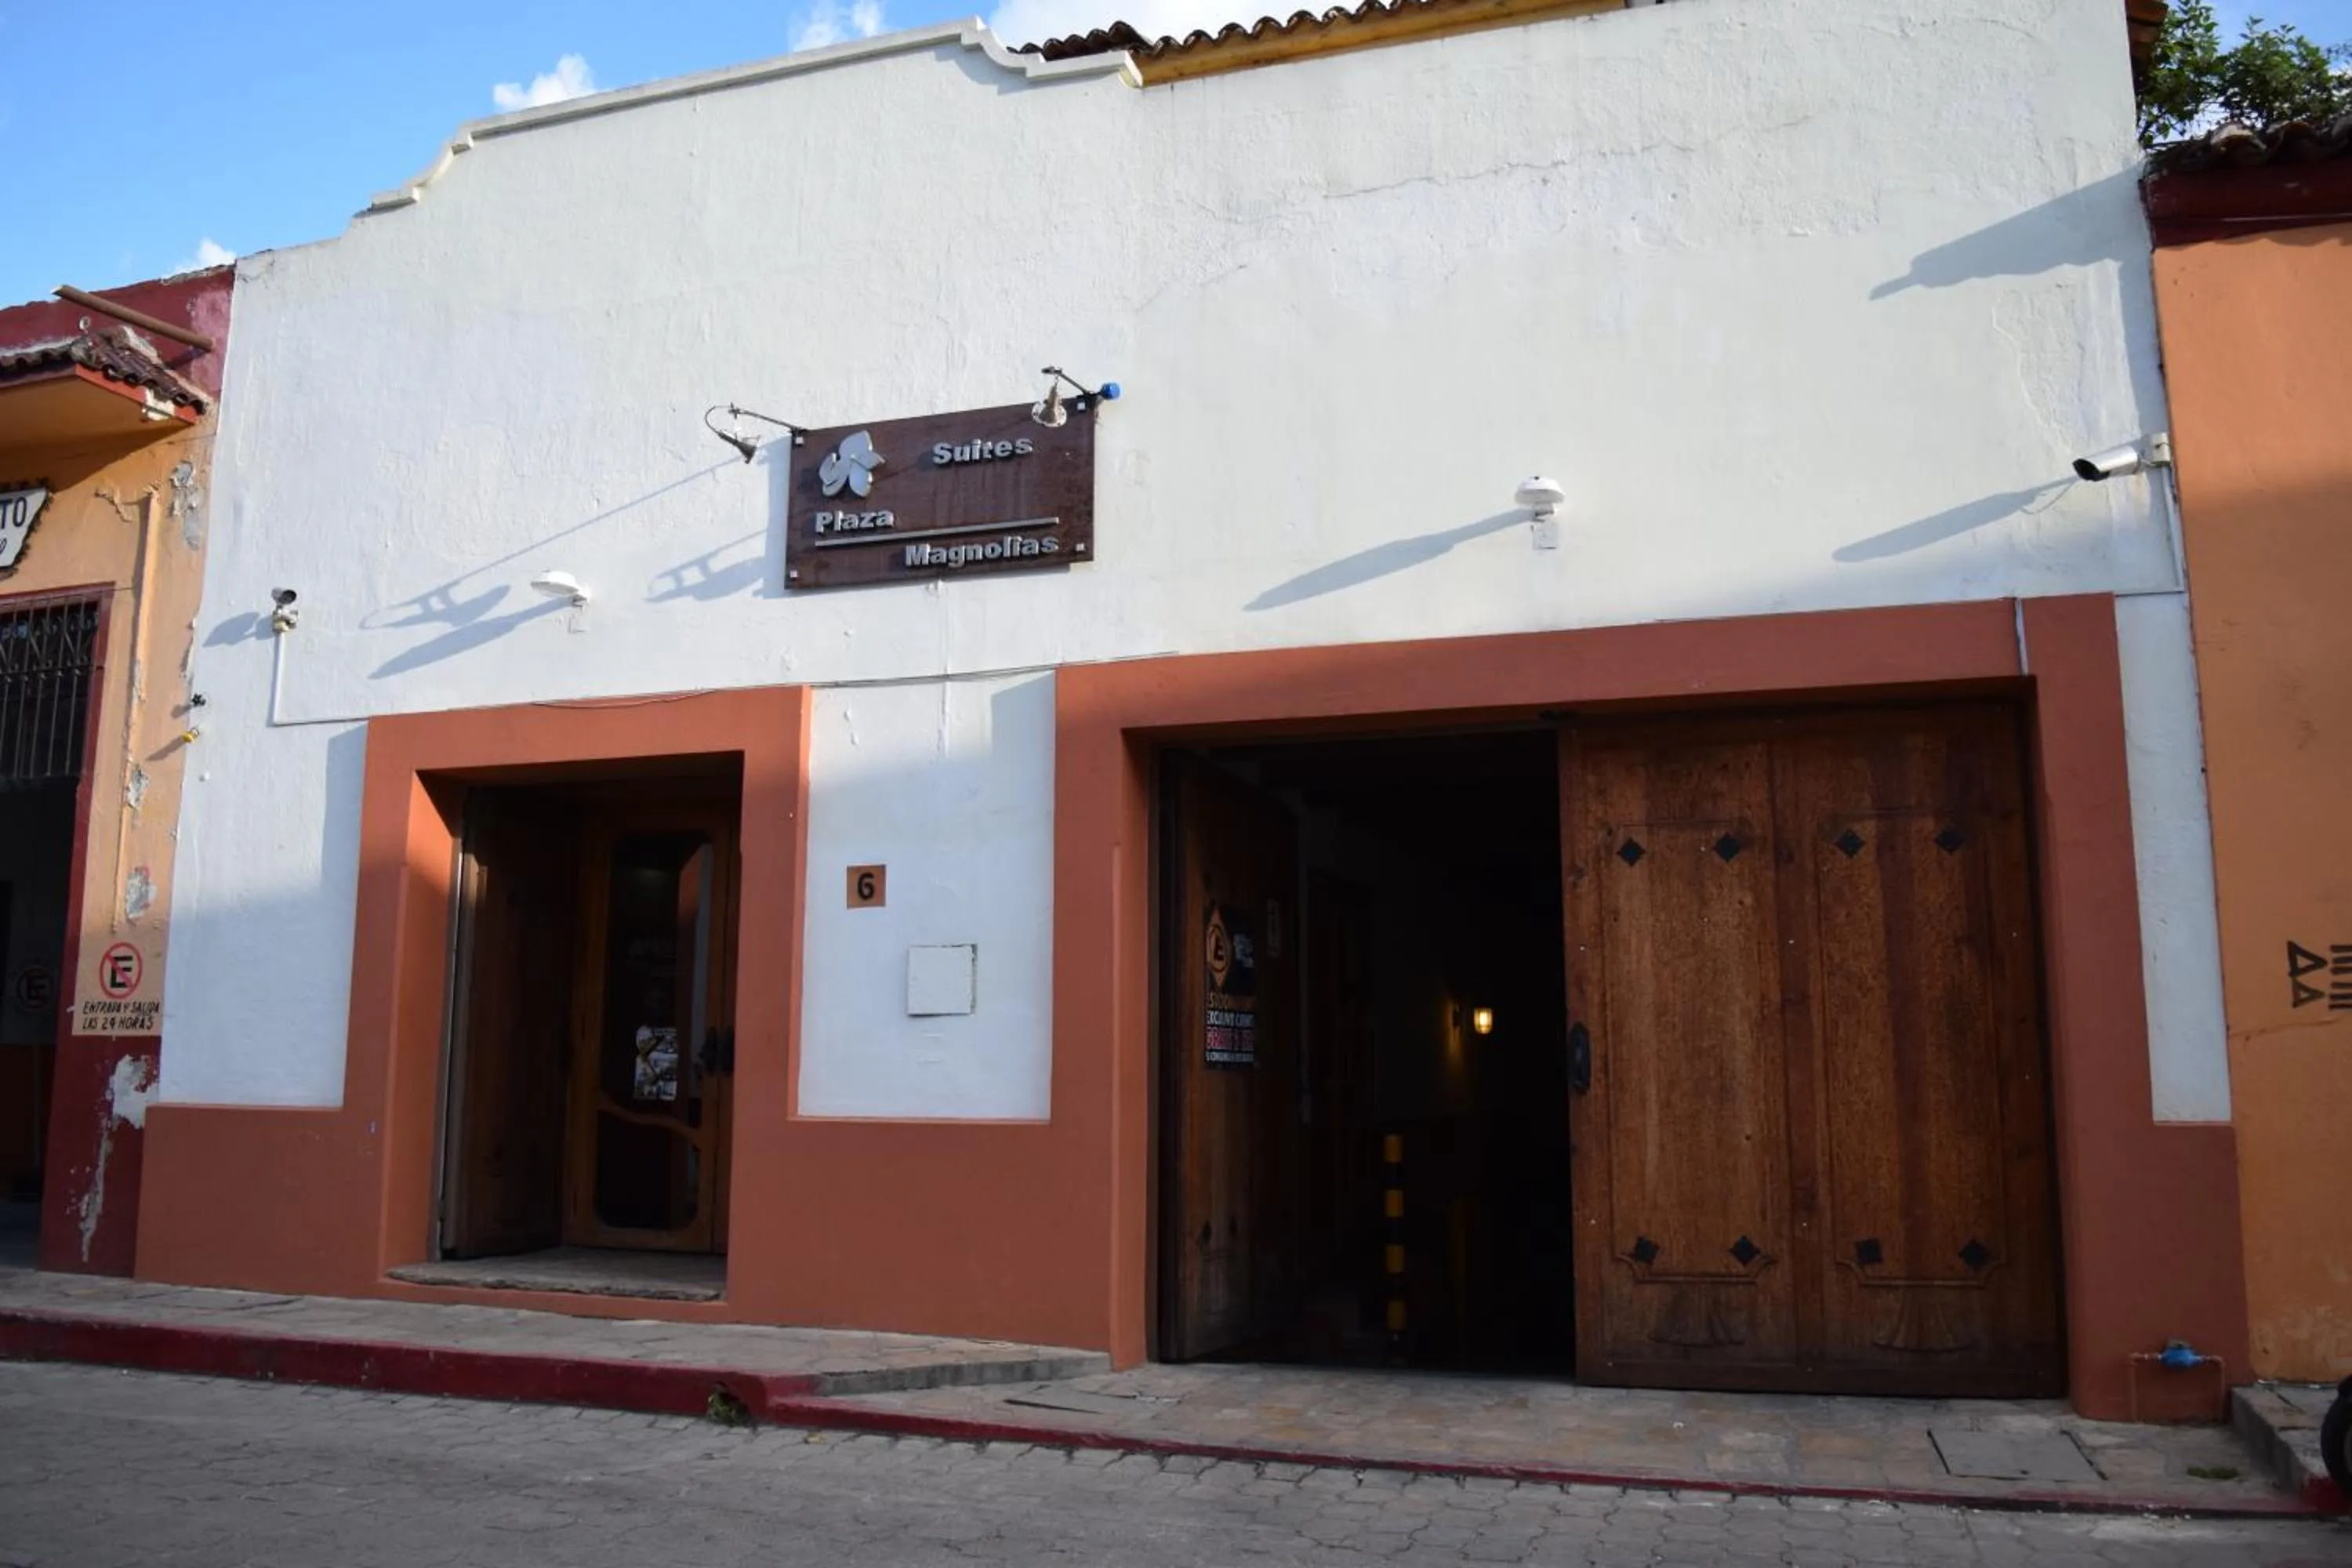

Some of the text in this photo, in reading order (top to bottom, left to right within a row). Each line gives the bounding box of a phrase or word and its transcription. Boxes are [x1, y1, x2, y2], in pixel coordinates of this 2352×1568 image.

[932, 437, 1034, 466] Suites
[815, 509, 895, 534] Plaza
[905, 535, 1059, 568] Magnolias
[857, 871, 876, 902] 6
[110, 955, 133, 989] E
[118, 1016, 154, 1030] HORAS
